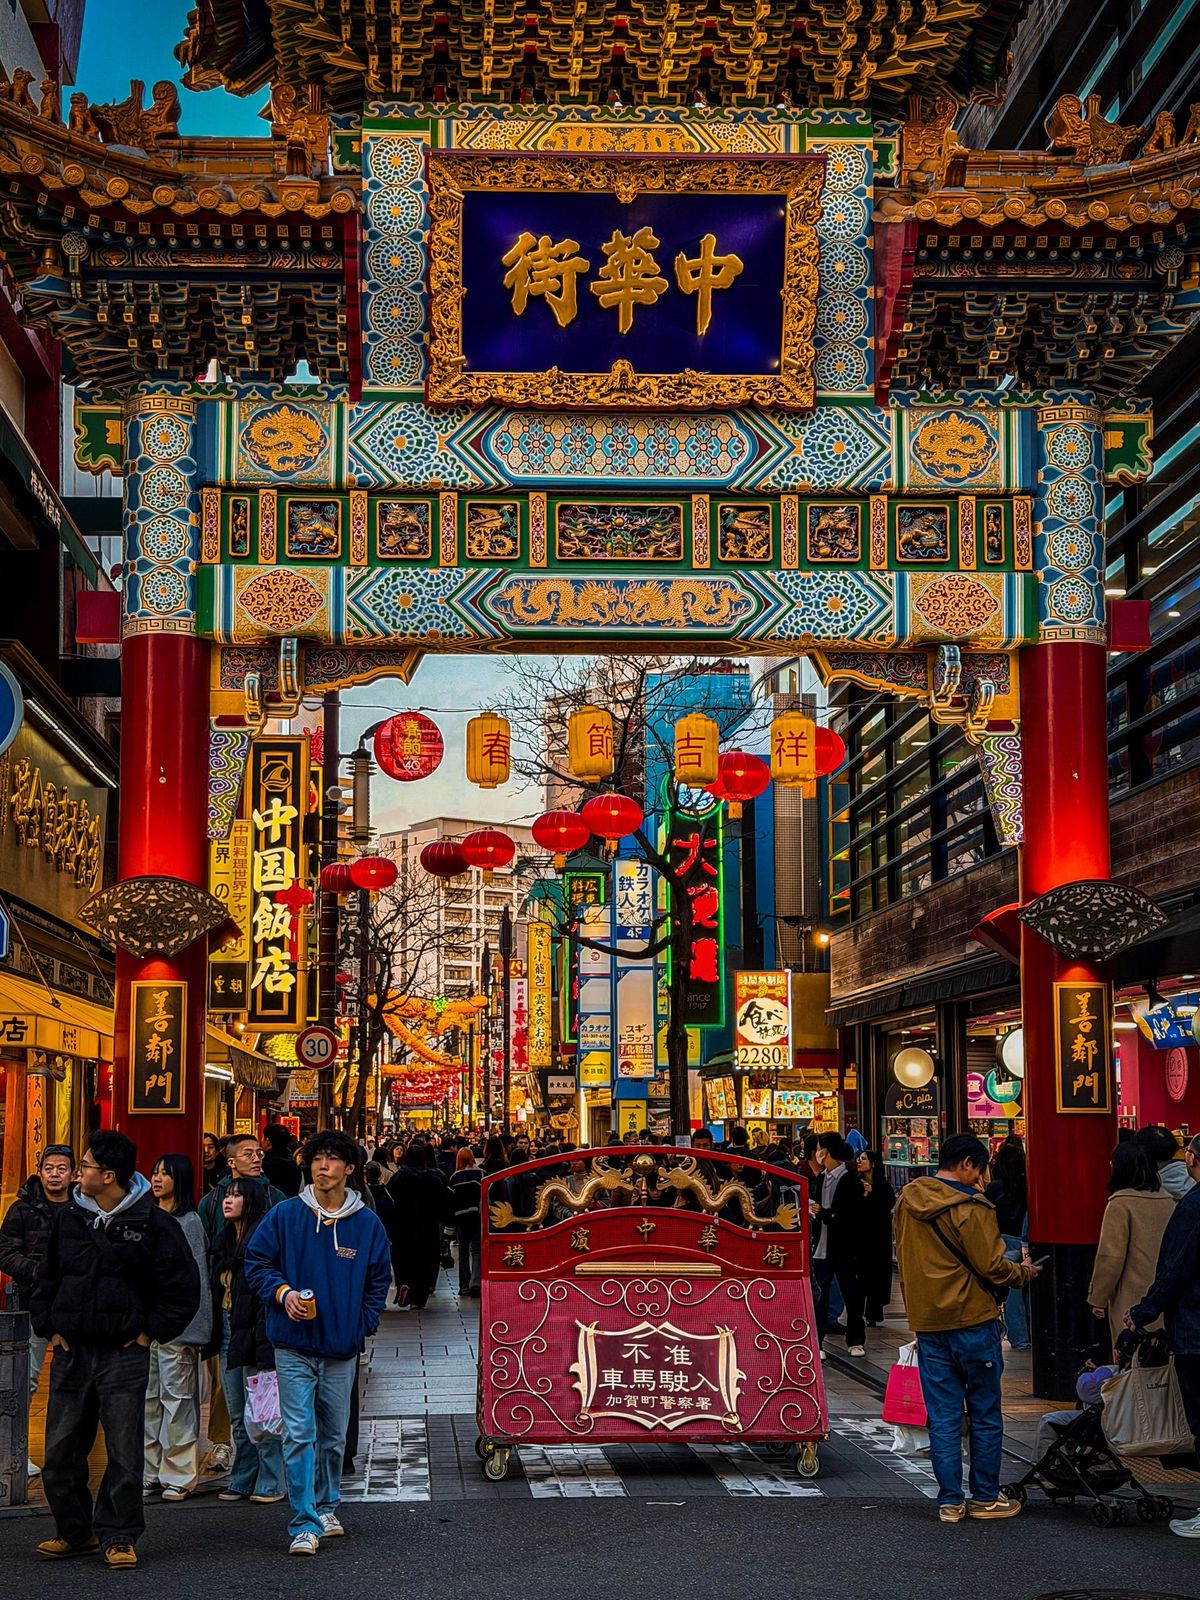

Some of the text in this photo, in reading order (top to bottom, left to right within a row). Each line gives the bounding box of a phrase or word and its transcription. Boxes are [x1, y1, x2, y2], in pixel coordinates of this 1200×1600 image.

[482, 730, 509, 767] 春
[586, 723, 613, 760] 節
[676, 732, 706, 768] 吉
[775, 731, 808, 767] 祥
[251, 797, 299, 994] 中国飯店
[619, 876, 635, 908] 鉄人
[619, 1034, 653, 1043] ドラッグ
[626, 1024, 648, 1033] スギ
[306, 1038, 328, 1057] 30
[627, 1045, 653, 1056] 化粧品
[740, 1047, 781, 1065] 2280
[622, 1343, 693, 1367] 不准
[598, 1368, 720, 1393] 車馬駛入
[605, 1394, 713, 1411] 加賀町警察署
